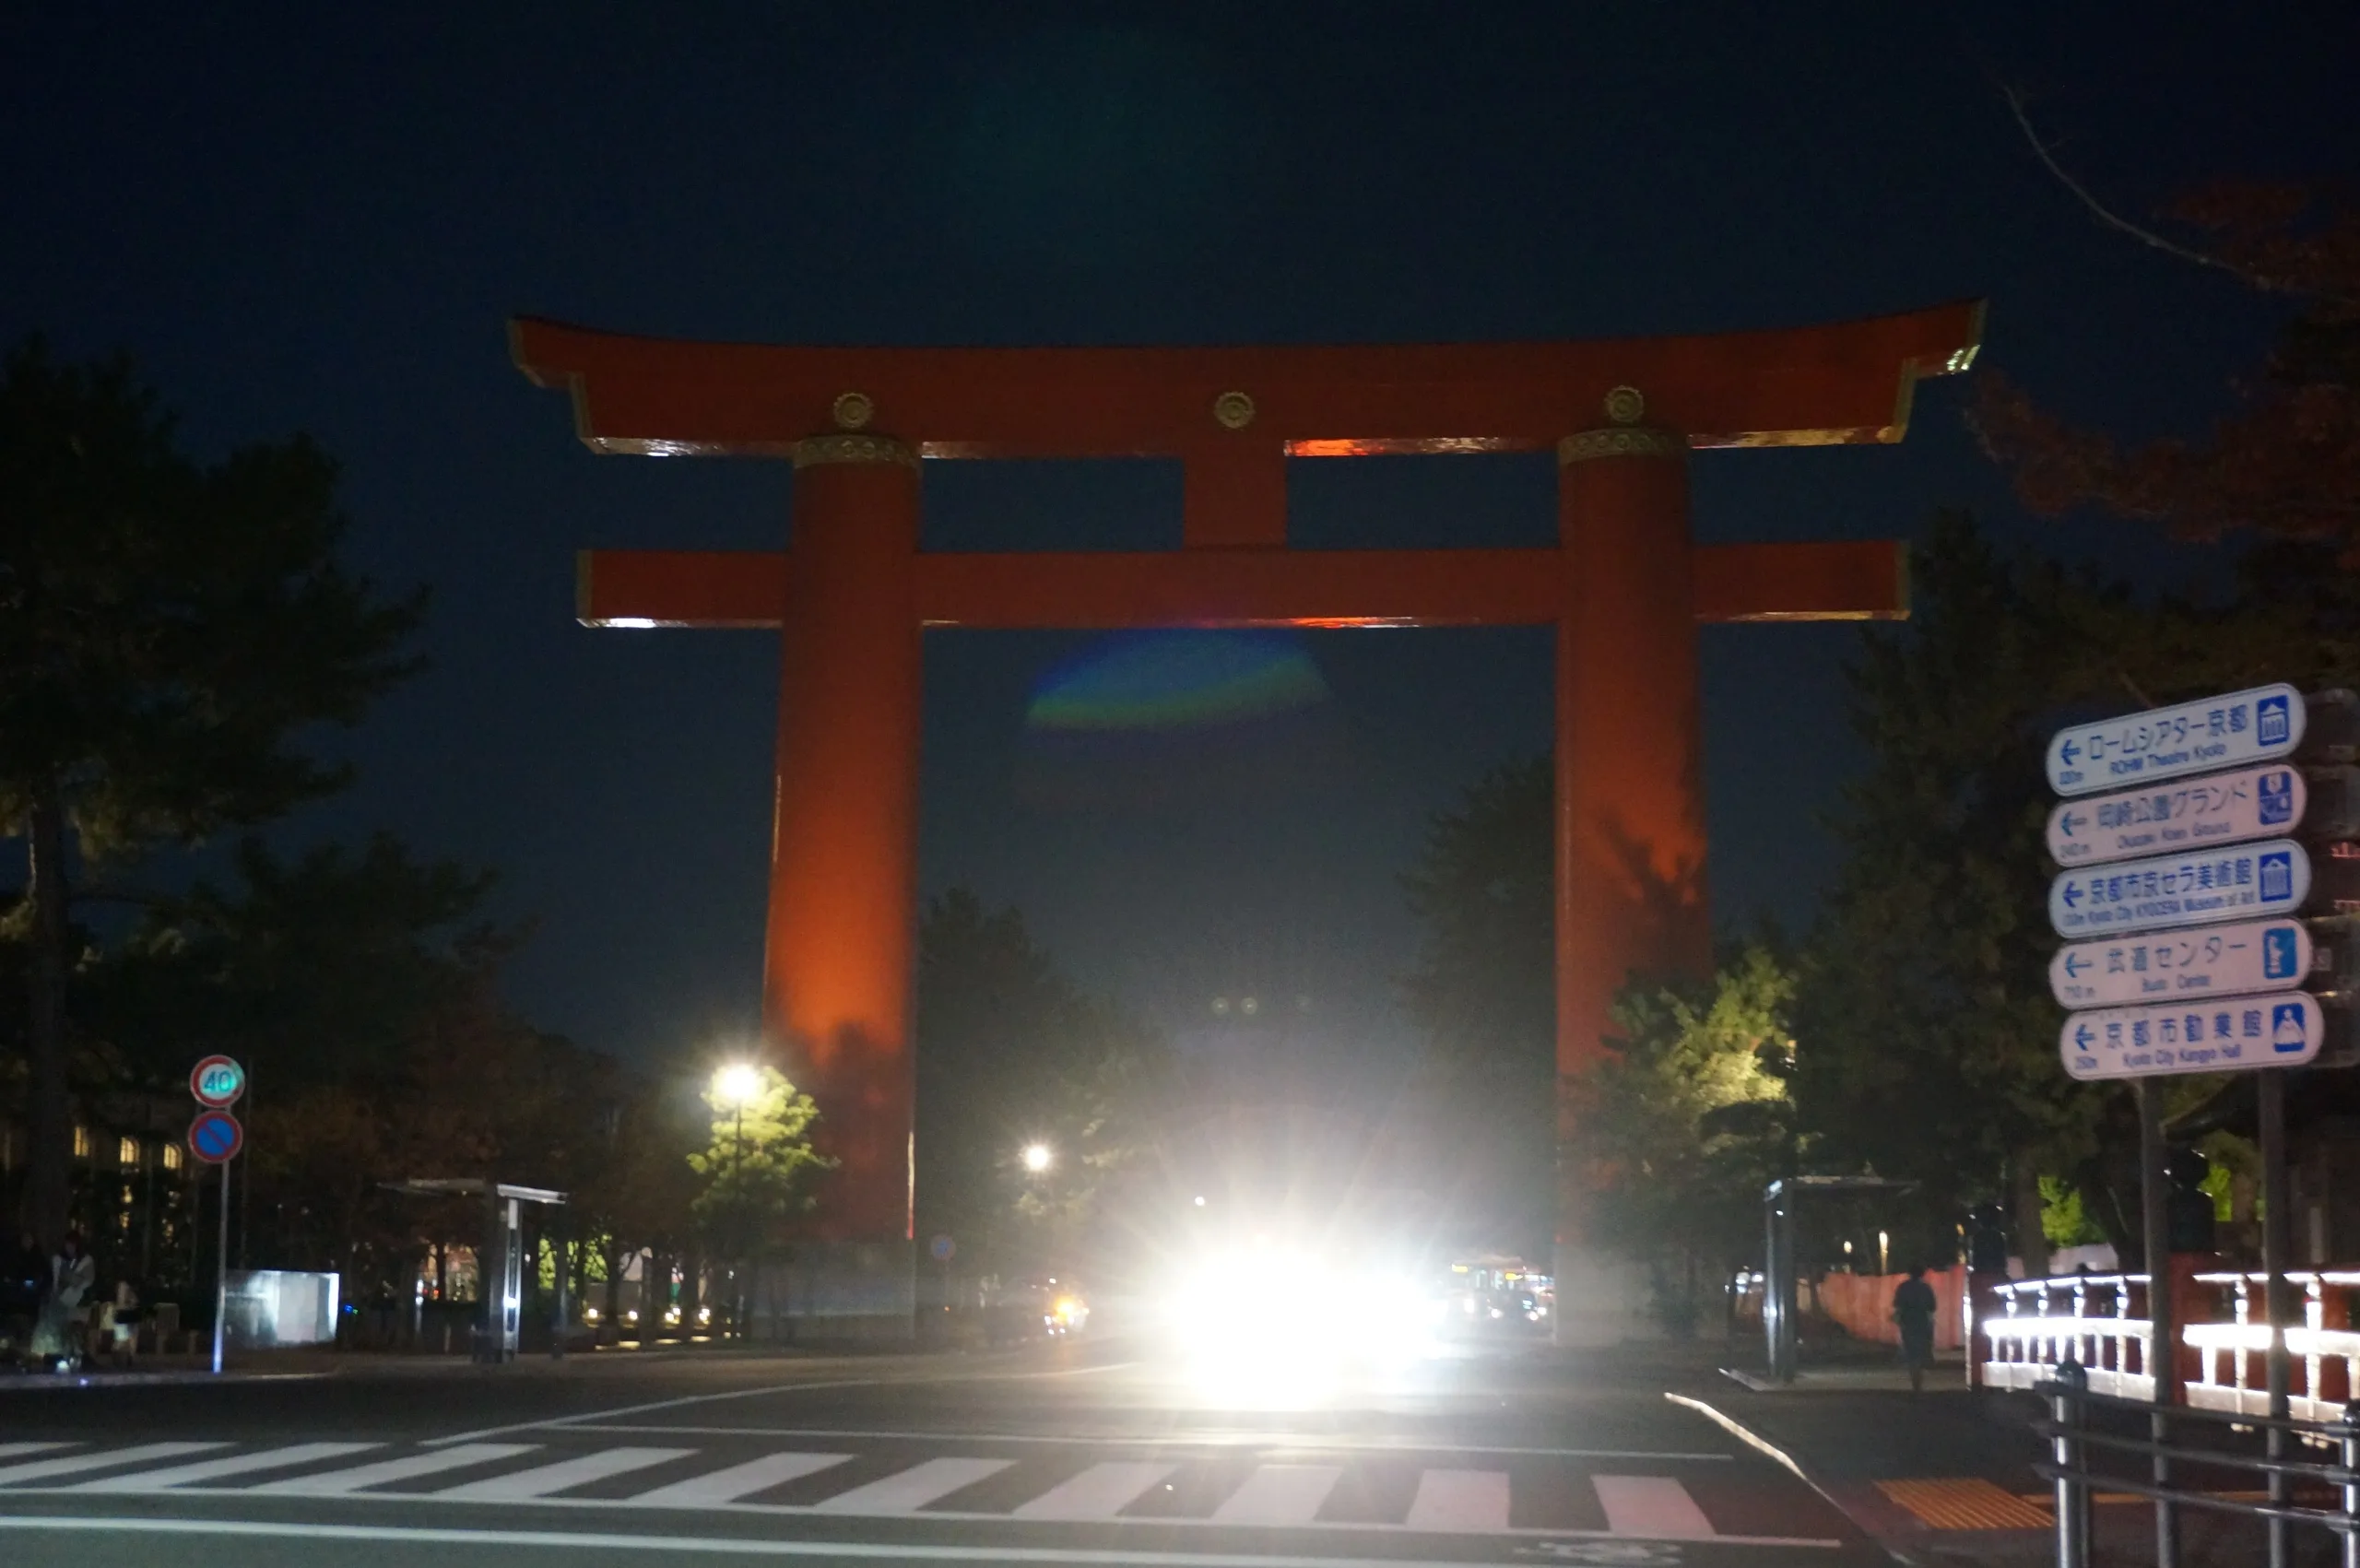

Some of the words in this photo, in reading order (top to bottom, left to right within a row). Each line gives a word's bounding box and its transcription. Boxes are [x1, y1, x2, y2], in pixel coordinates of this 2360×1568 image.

[2089, 704, 2248, 760] ロームシアター京都
[2194, 743, 2226, 760] Kyoto
[2090, 858, 2251, 904] 京都市京セラ美術館
[2107, 936, 2248, 973] 武道センター
[2106, 1009, 2262, 1049] 京都市勧業館
[2123, 1053, 2152, 1067] Kyoto
[2155, 1049, 2175, 1066] City
[204, 1069, 231, 1092] 40
